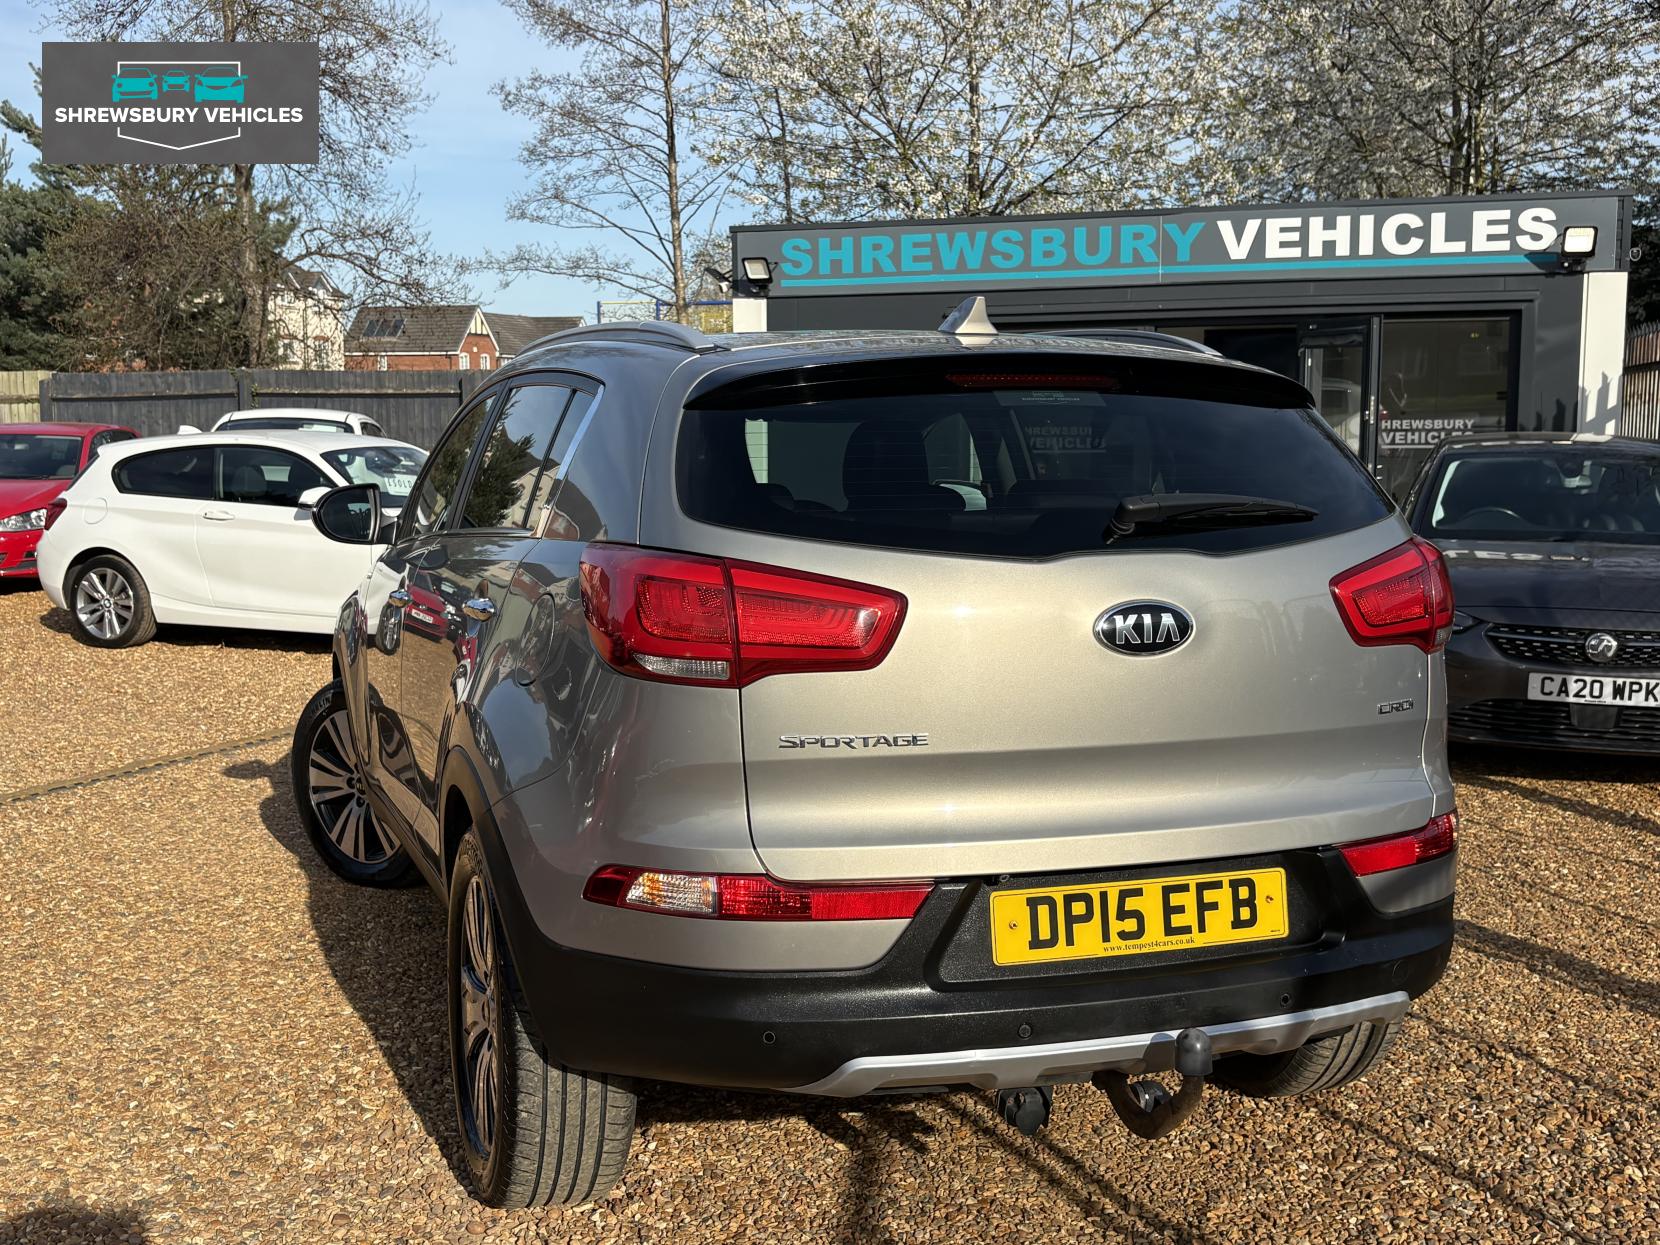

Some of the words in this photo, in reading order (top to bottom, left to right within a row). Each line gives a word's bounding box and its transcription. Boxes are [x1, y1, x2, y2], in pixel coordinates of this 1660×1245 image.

[780, 222, 1207, 276] SHREWSBURY
[1216, 207, 1558, 260] VEHICLES
[1381, 418, 1475, 430] HREWSBURY
[1113, 612, 1181, 645] KIA
[1539, 676, 1604, 700] CA20
[1611, 679, 1660, 703] WPK
[778, 732, 930, 750] SPORTAGE
[1025, 887, 1146, 950] DP15
[1161, 877, 1259, 937] EFB
[1103, 936, 1196, 953] www.tempest4cars.co.uk
